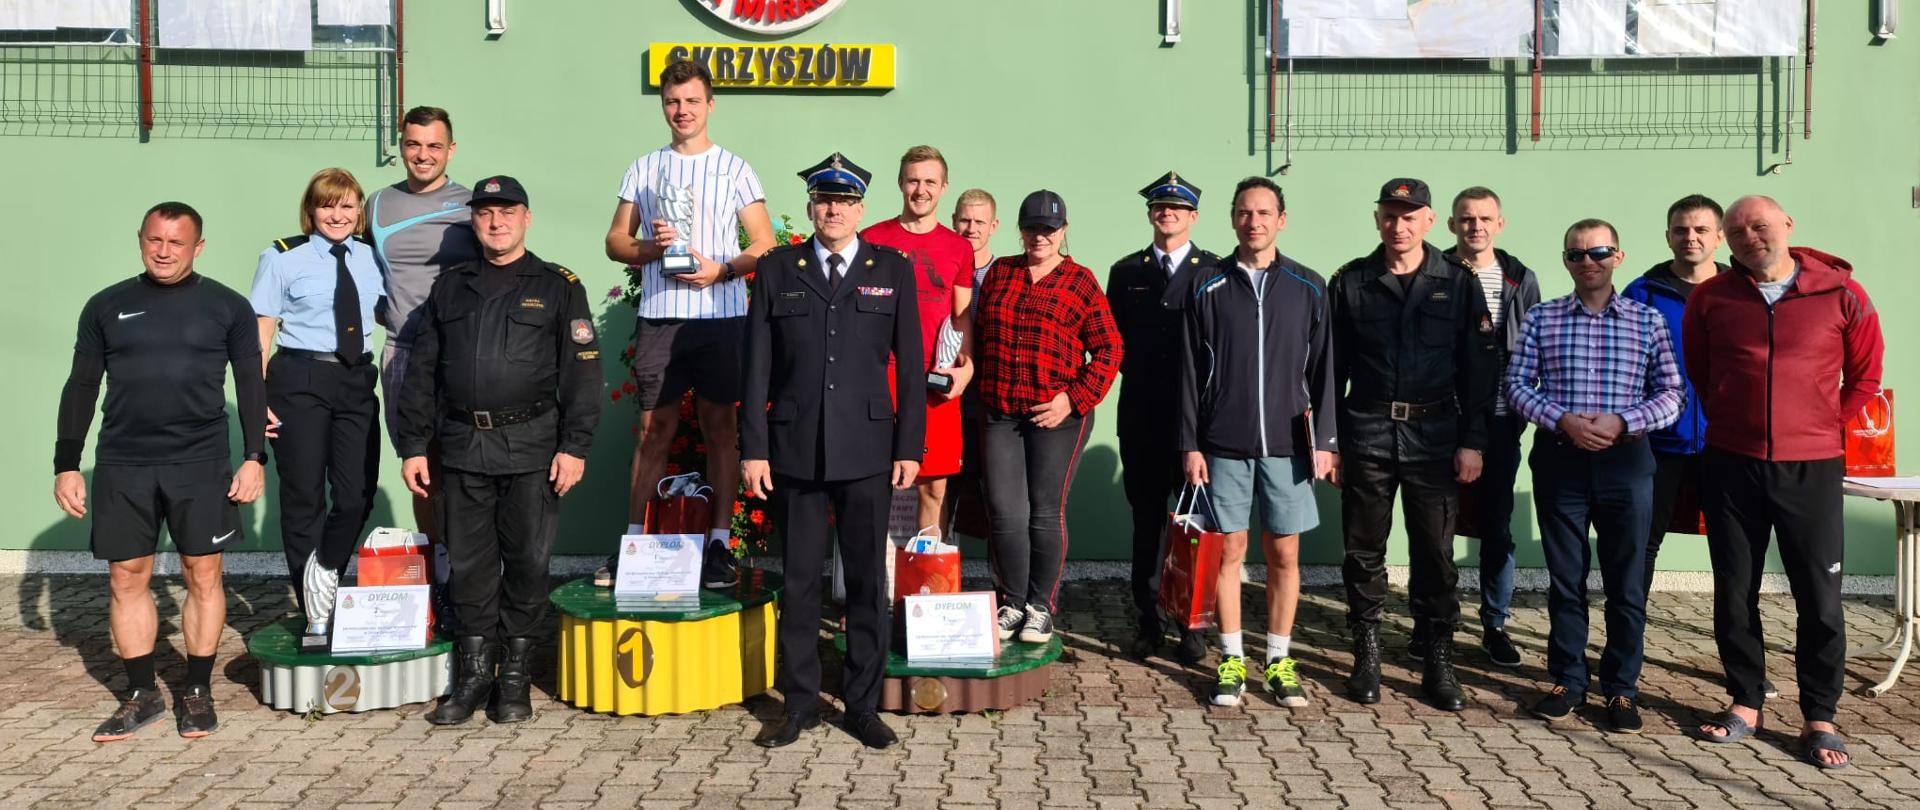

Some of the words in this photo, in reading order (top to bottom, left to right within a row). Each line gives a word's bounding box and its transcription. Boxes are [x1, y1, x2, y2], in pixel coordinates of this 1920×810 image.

[368, 592, 409, 601] DYPLOM
[935, 602, 972, 610] DYPLOM
[618, 631, 643, 682] 1
[327, 668, 356, 707] 2
